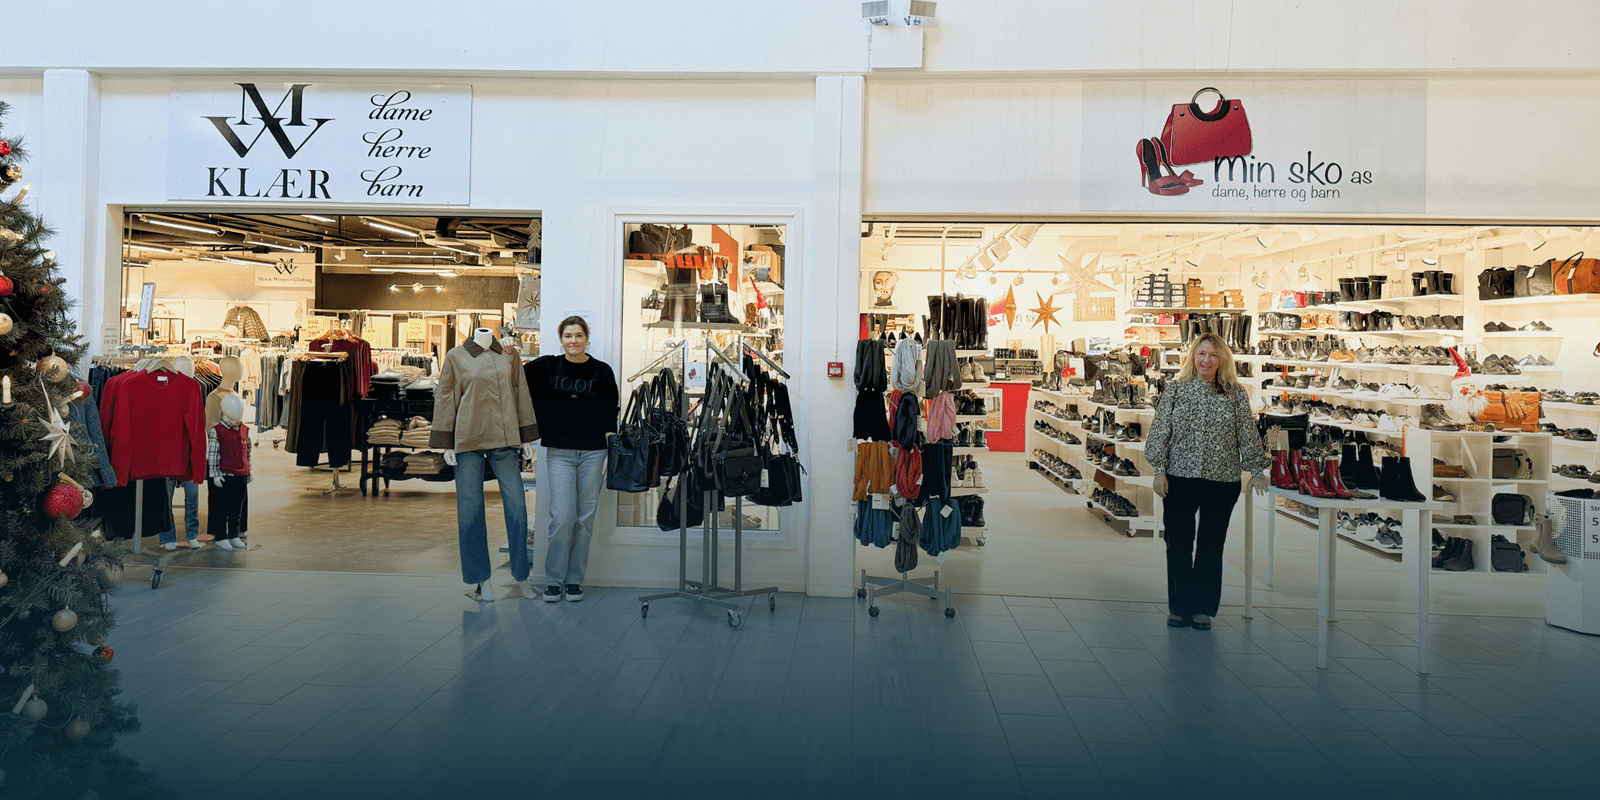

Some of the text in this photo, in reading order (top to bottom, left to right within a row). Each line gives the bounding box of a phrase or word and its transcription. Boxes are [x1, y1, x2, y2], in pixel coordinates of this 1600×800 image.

[368, 90, 433, 121] dame
[362, 128, 432, 159] herre
[205, 167, 332, 199] KLÆR
[360, 165, 424, 197] barn
[1213, 151, 1373, 186] min sko as
[1212, 184, 1340, 202] dame, herre og barn
